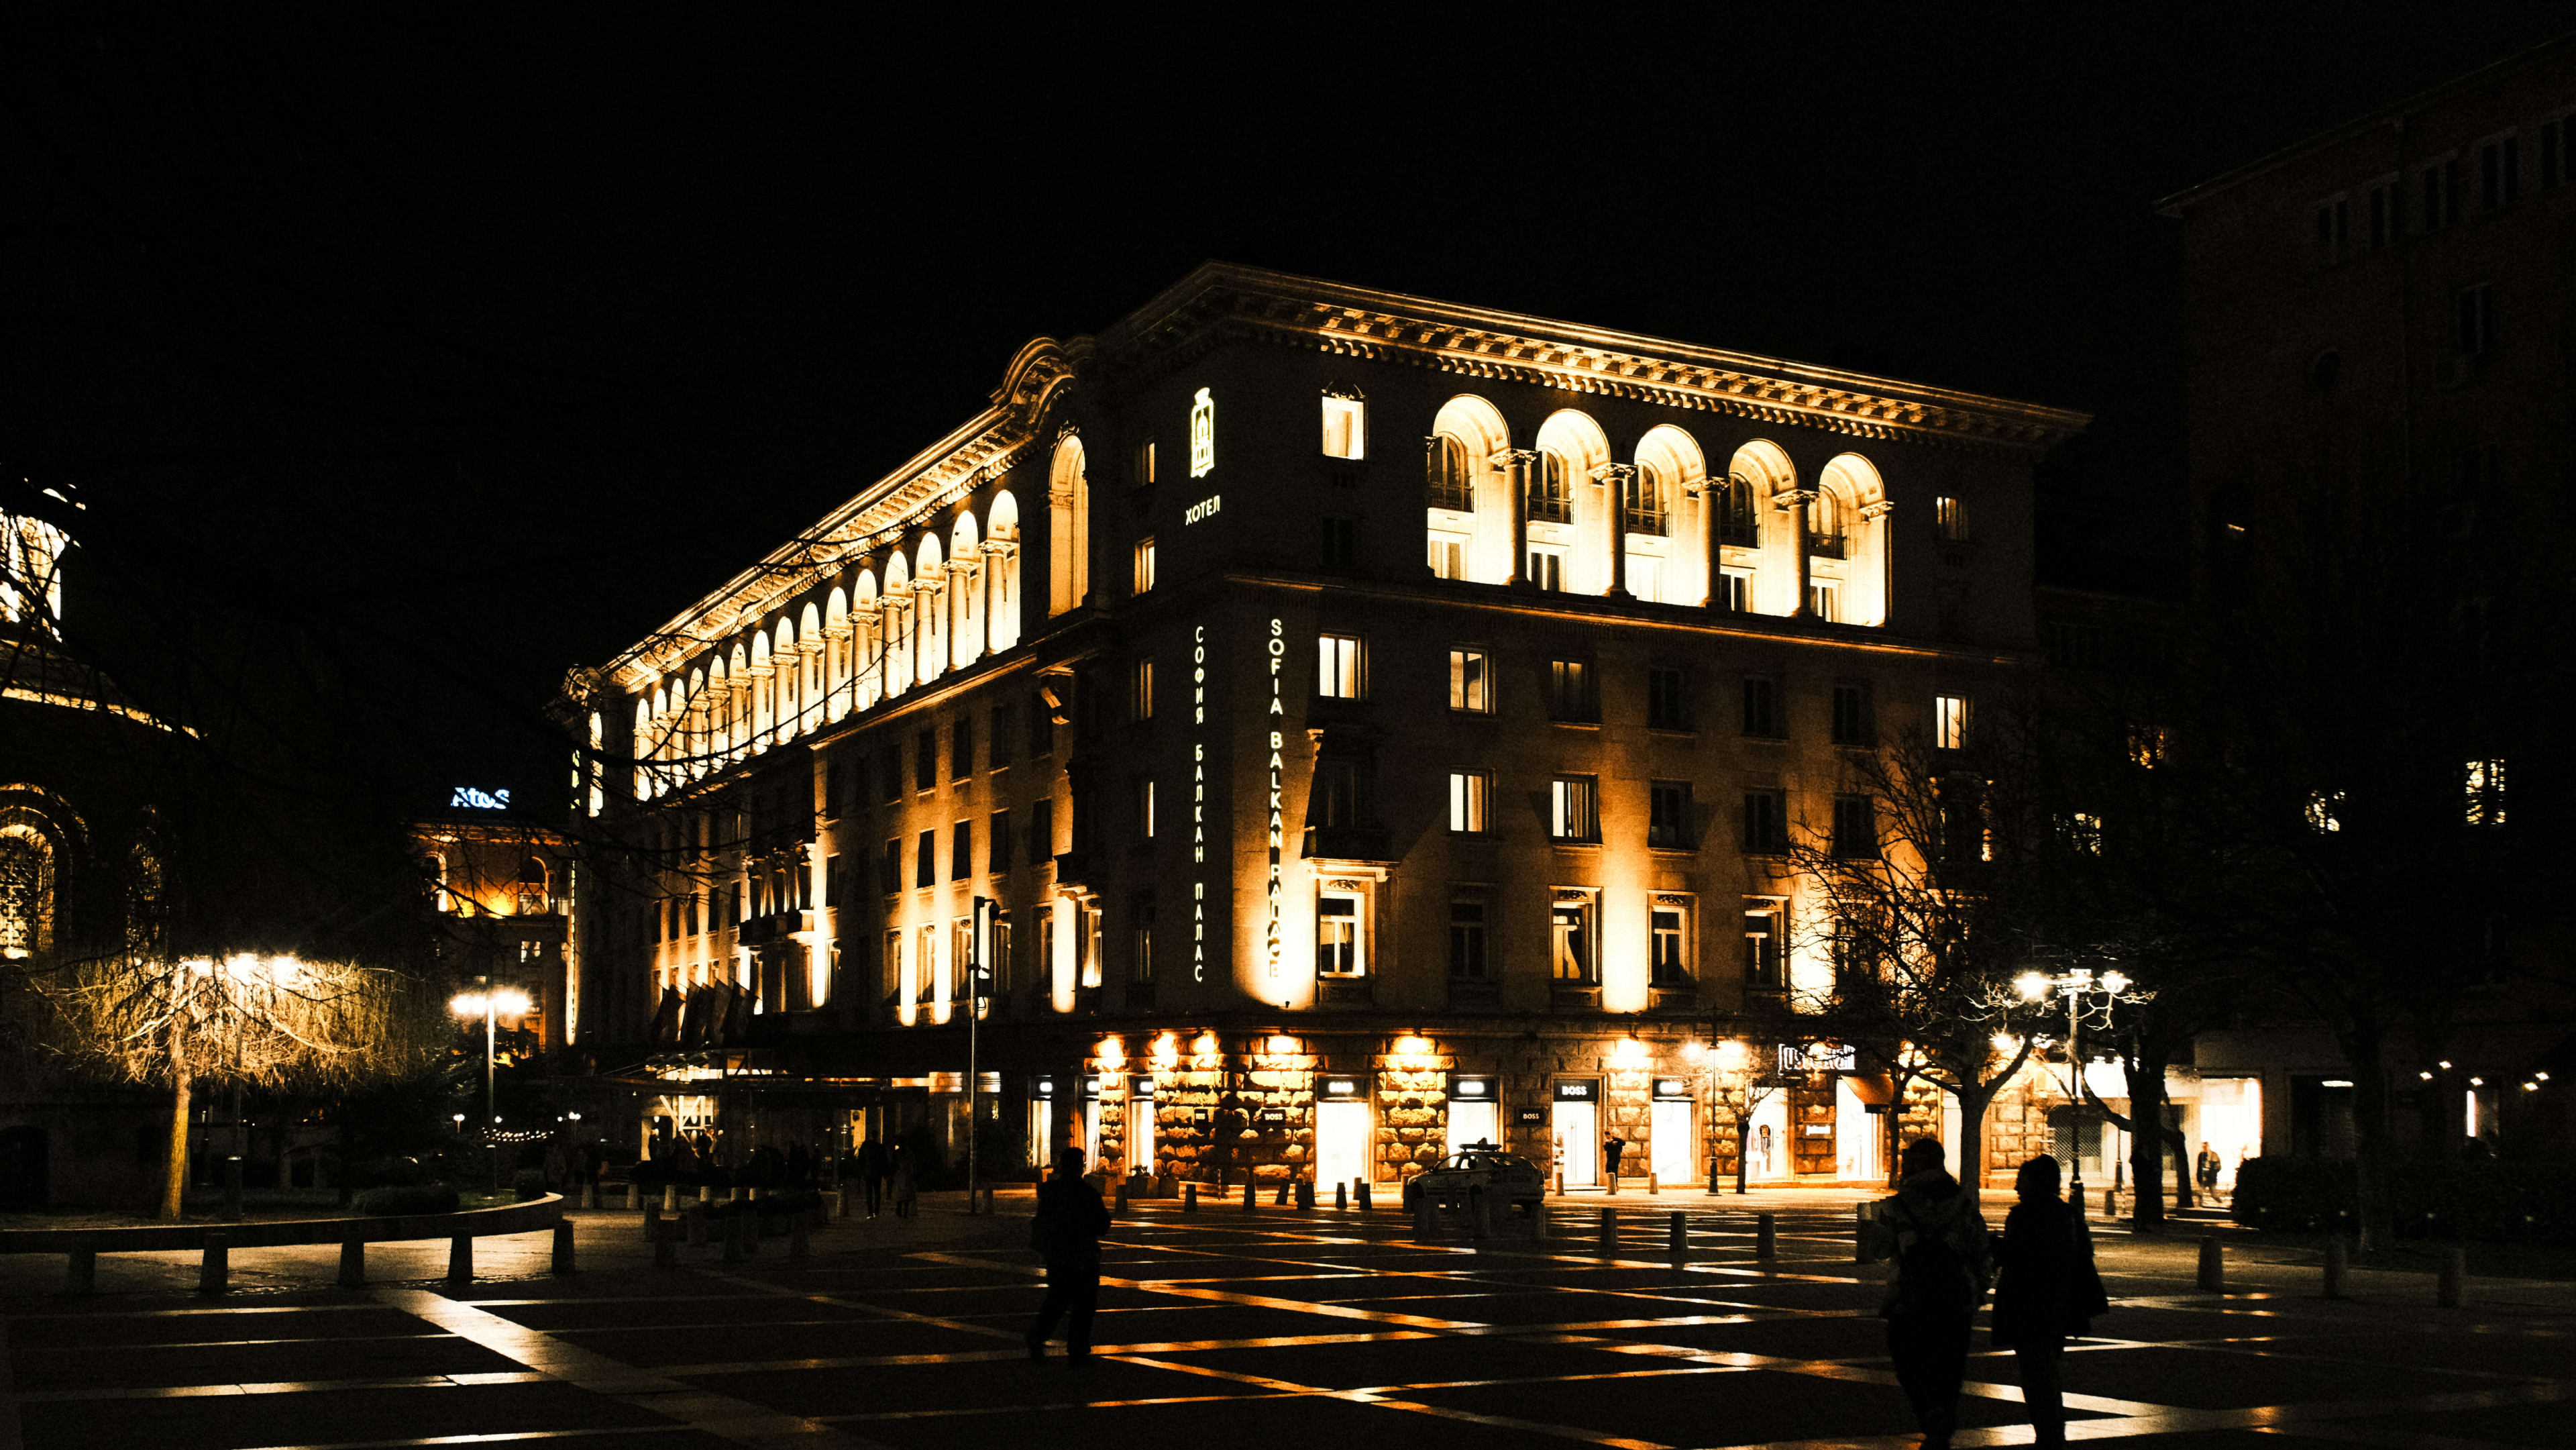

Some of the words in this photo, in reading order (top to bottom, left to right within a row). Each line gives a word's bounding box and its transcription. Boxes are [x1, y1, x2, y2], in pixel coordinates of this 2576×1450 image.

[1185, 495, 1220, 526] ХОТЕЛ
[1194, 625, 1205, 725] СОФИЯ
[1269, 619, 1285, 715] SOFIA
[450, 787, 510, 810] Atos
[1195, 745, 1203, 863] БАЛКАН
[1269, 731, 1283, 848] BALKAN
[1195, 882, 1203, 982] ПАЛАС
[1269, 864, 1283, 979] PALACE
[1562, 1086, 1587, 1096] BOSS
